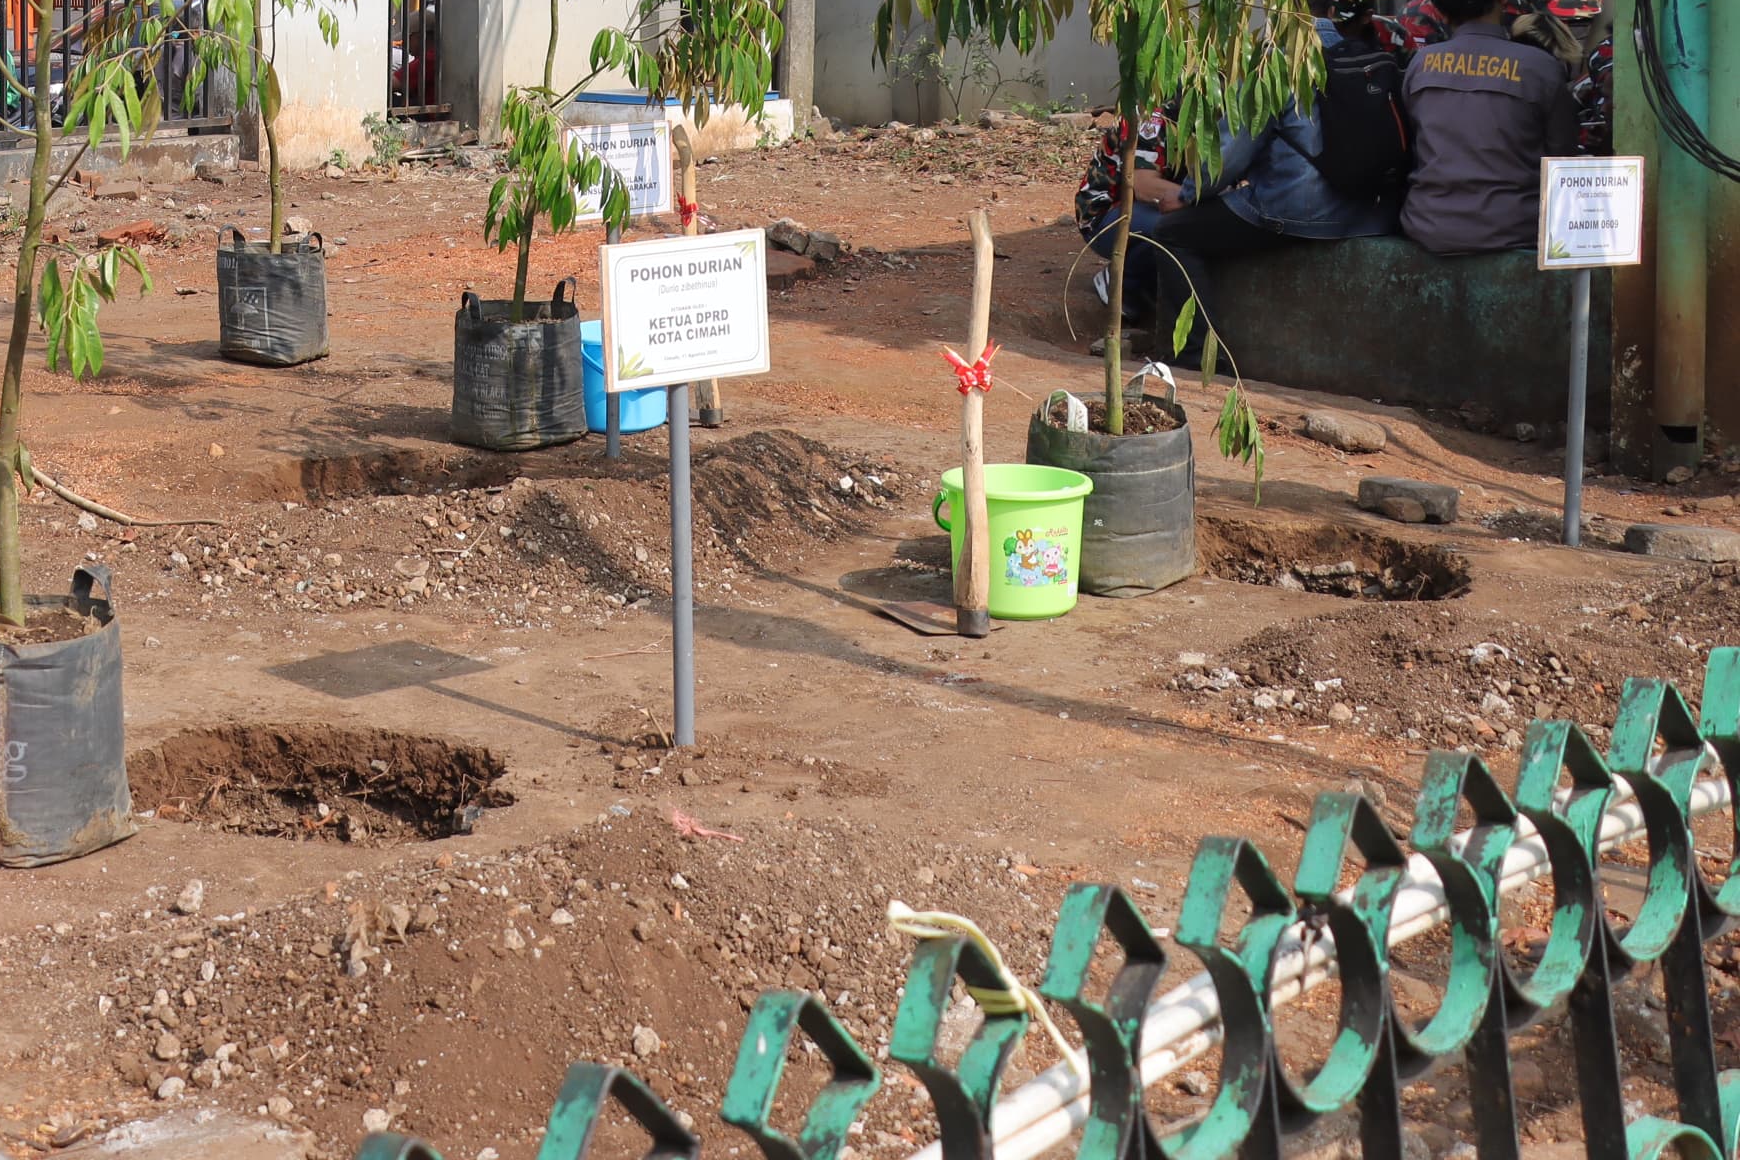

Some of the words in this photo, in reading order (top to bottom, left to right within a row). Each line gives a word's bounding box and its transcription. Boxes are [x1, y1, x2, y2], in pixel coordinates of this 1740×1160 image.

[1423, 51, 1522, 82] PARALEGAL
[581, 139, 617, 153] POHON
[620, 136, 657, 149] DURIAN
[1560, 177, 1593, 188] POHON
[1595, 175, 1629, 187] DURIAN
[1568, 220, 1599, 230] DANDIM
[630, 263, 683, 282] POHON
[688, 256, 742, 276] DURIAN
[649, 314, 693, 330] KETUA
[696, 309, 729, 324] DPRD
[648, 330, 683, 346] KOTA
[686, 323, 731, 341] CIMAHI
